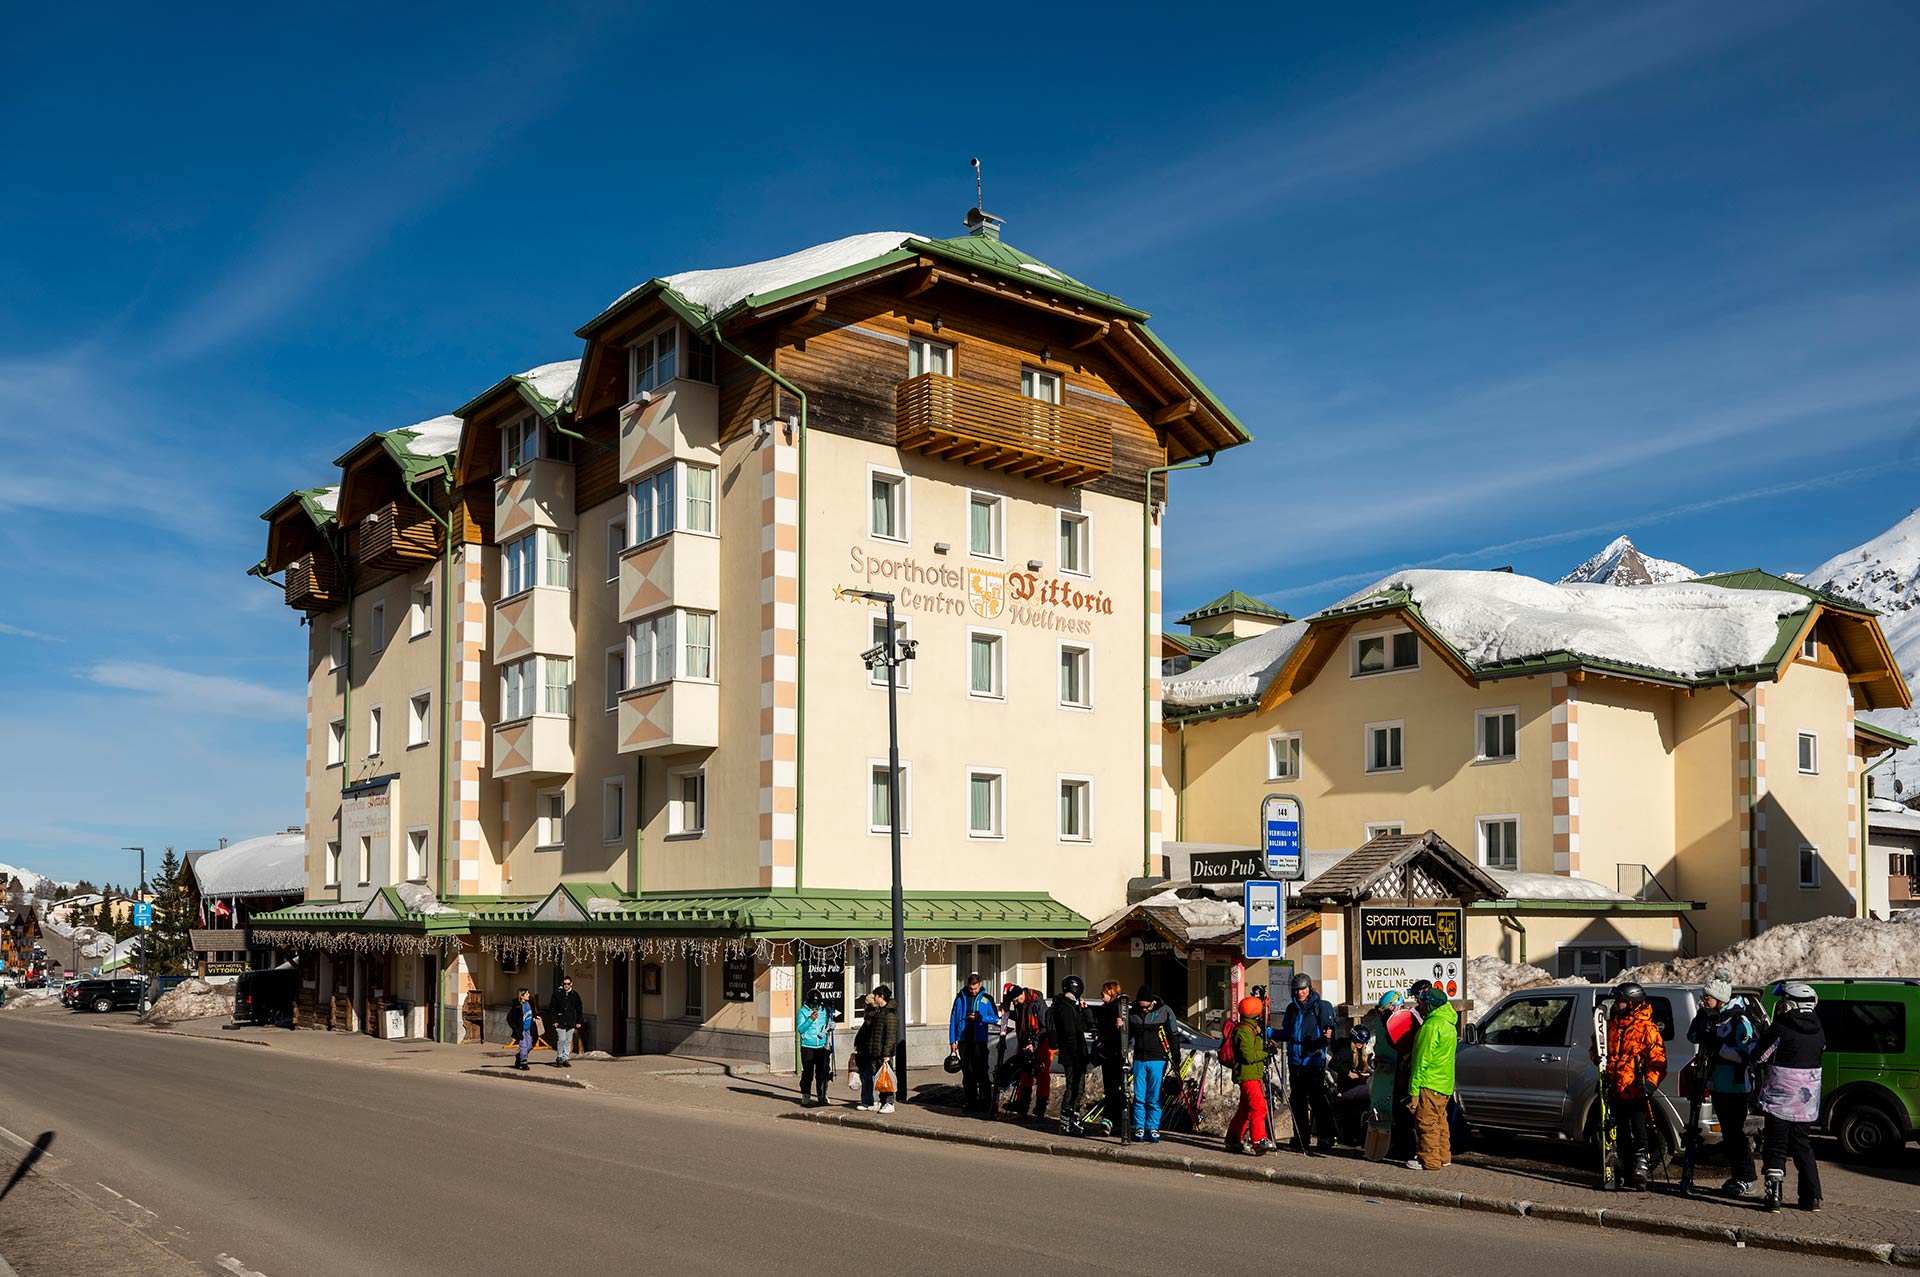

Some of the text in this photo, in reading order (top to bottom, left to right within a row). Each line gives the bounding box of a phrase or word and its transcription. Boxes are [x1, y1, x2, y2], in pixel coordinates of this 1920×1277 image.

[850, 546, 1114, 615] Sporthotel Vittoria
[901, 586, 1092, 635] Centro Wellness
[1278, 808, 1287, 816] 148
[1193, 858, 1256, 877] Disco Pub
[139, 904, 147, 914] P
[1366, 915, 1436, 926] SPORT HOTEL
[1366, 930, 1437, 945] VITTORIA
[808, 965, 840, 973] Disco Pub
[1366, 967, 1406, 977] PISCINA
[1367, 979, 1420, 989] WELLNES
